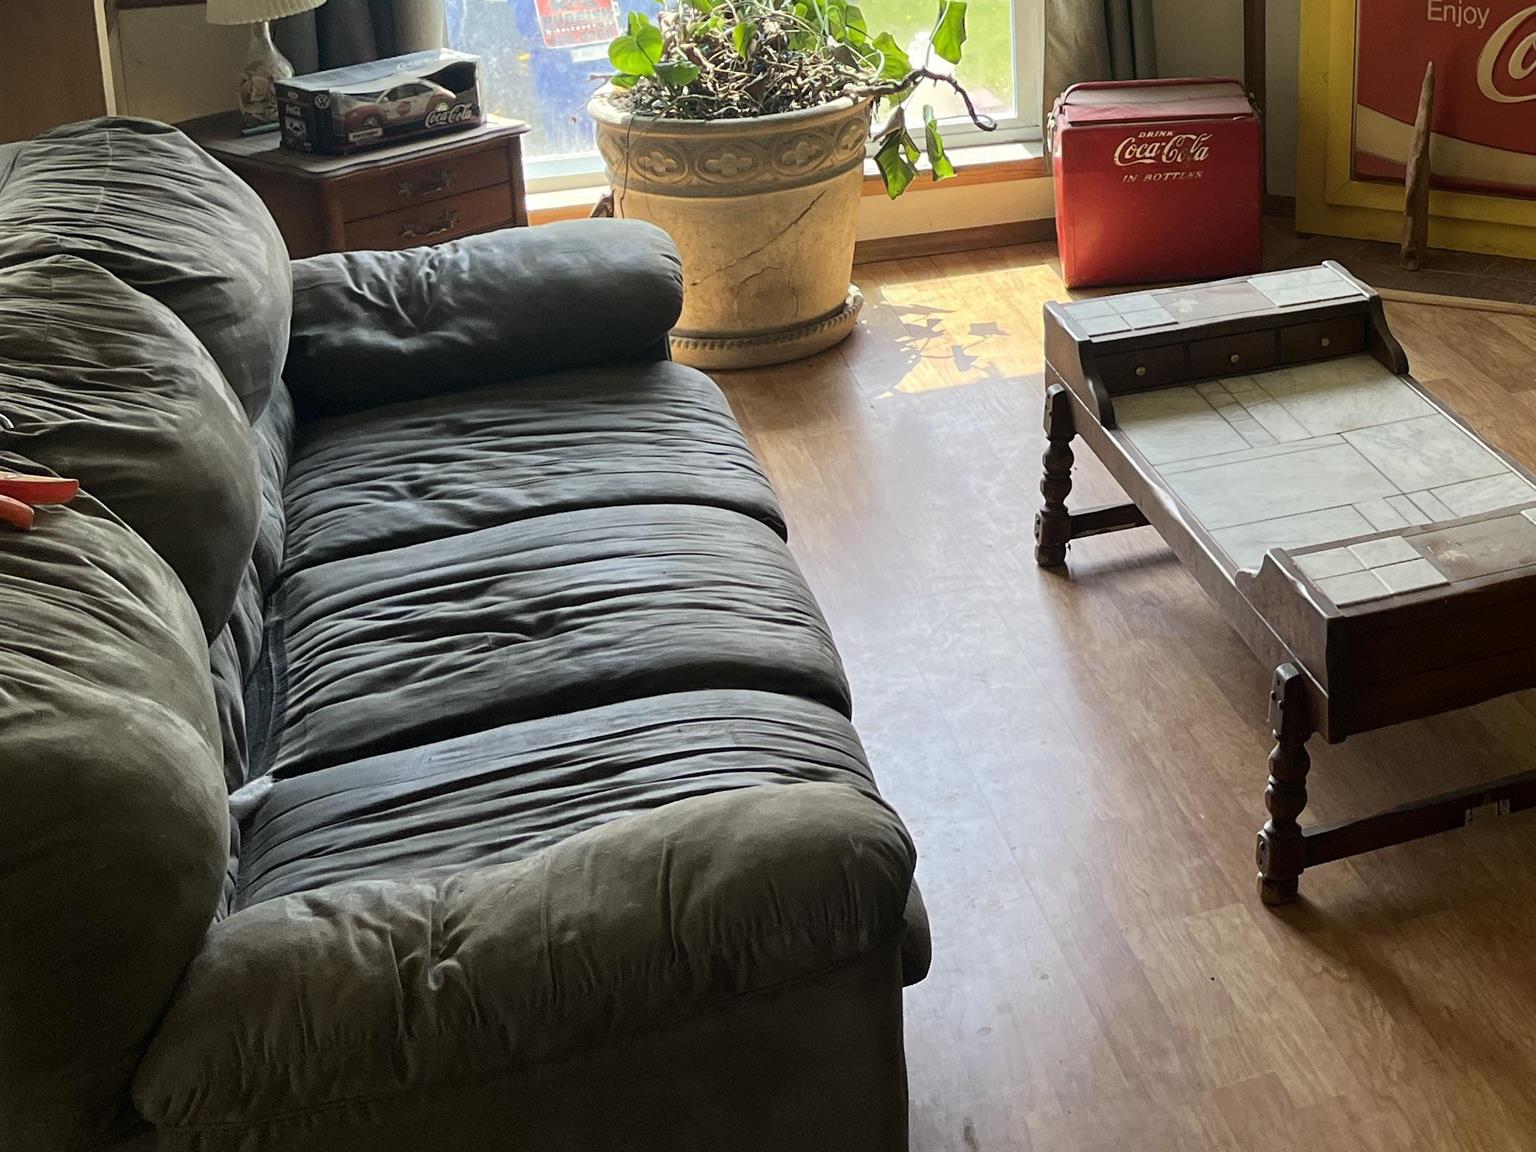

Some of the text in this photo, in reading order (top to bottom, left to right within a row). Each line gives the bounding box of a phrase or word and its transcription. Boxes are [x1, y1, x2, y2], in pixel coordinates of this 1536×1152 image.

[1138, 130, 1175, 138] DRINK
[1113, 133, 1213, 167] Coca-Cola
[1122, 170, 1204, 183] IN BOTTLES
